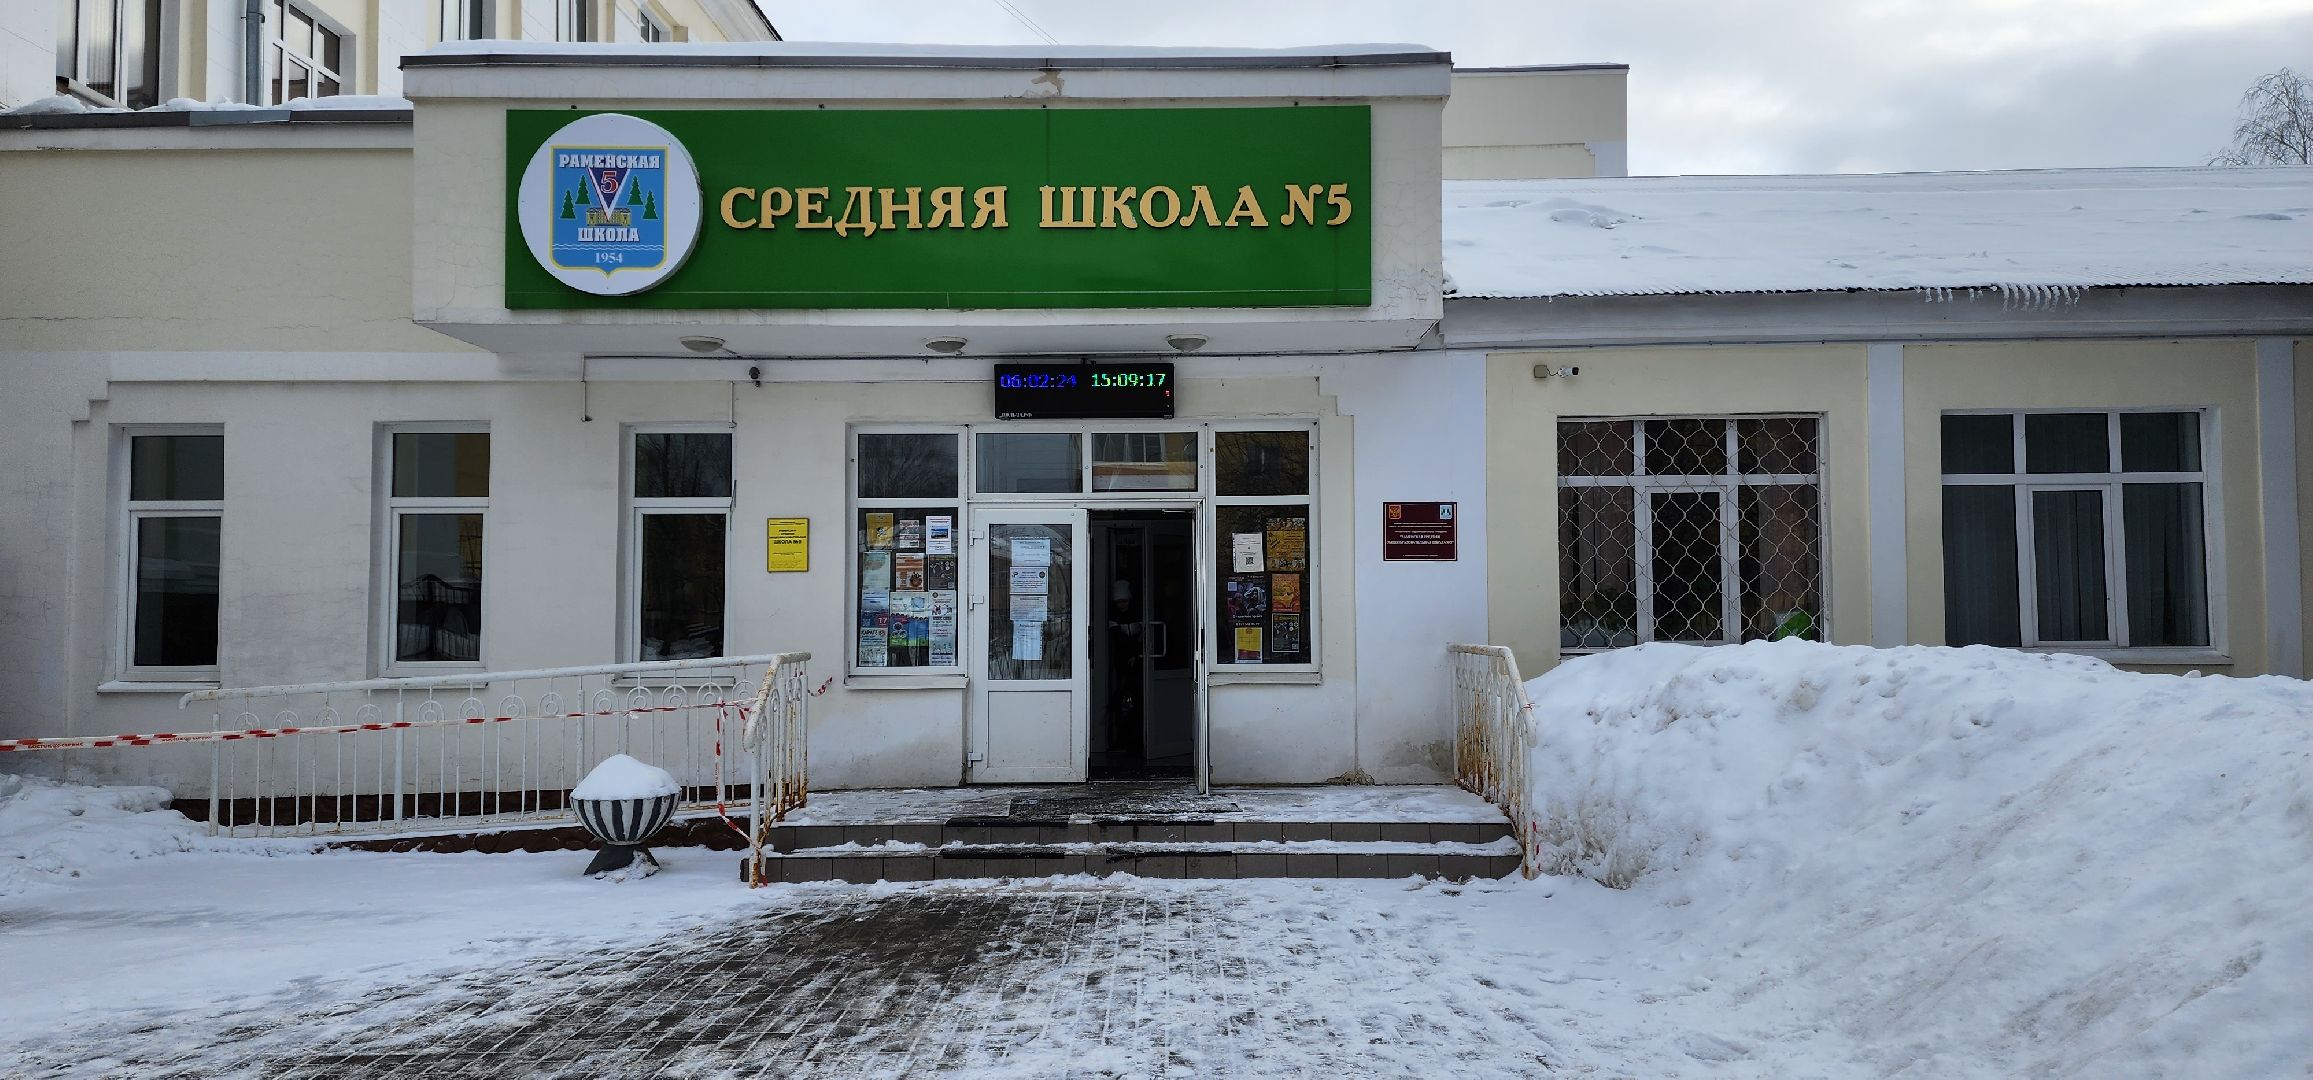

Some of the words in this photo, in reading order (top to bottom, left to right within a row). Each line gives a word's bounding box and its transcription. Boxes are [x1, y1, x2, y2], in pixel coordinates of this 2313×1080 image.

[559, 153, 660, 169] РАМЕНСКАЯ
[599, 170, 619, 194] 5
[720, 186, 1009, 238] СРЕДНЯЯ
[1039, 185, 1269, 230] ШКОЛА
[577, 227, 640, 242] ШКОЛА
[594, 252, 624, 264] 1954
[1000, 374, 1077, 388] 06:02:24
[1091, 373, 1167, 387] 15:09:17
